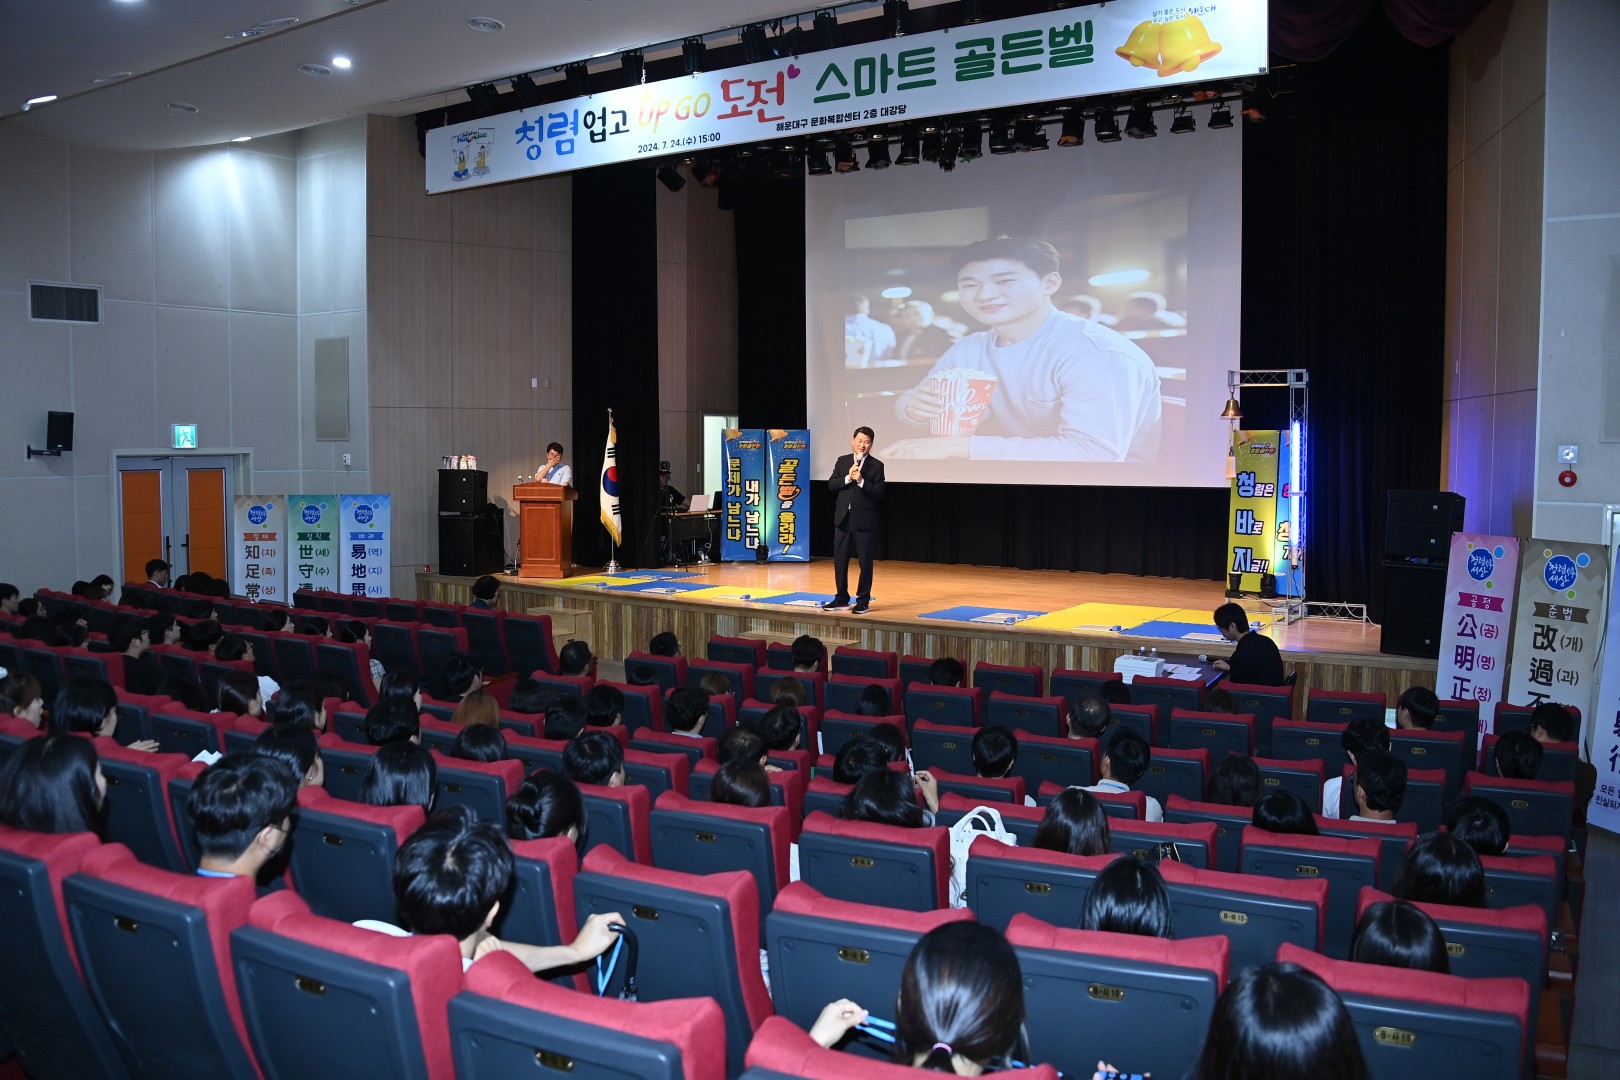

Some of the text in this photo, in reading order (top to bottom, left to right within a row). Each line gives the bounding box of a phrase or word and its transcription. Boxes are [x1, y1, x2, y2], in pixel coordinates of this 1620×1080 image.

[514, 19, 1095, 160] 청렴 업고 UP GO 도전 스마트 골든벨
[776, 104, 908, 132] 해운대구 문화복합센터 2층 대강당
[638, 142, 660, 154] 2024.
[662, 140, 669, 150] 7.
[698, 132, 721, 144] 15:00
[1236, 471, 1274, 498] 청렴은
[726, 458, 741, 542] 문제가 남느냐
[745, 480, 760, 550] 내가 남느냐
[1235, 509, 1264, 535] 바로
[244, 544, 276, 560] 知 (지)
[299, 544, 329, 559] 世 (세)
[351, 544, 382, 560] 易 (역)
[1233, 547, 1270, 573] 지금!!
[245, 564, 276, 578] 足 (족)
[299, 564, 329, 578] 守 (수)
[351, 564, 382, 578] 地 (지)
[1549, 574, 1570, 587] 세상
[262, 586, 276, 595] (상)
[368, 586, 382, 594] (사)
[1471, 595, 1491, 609] 공정
[1548, 604, 1573, 620] 준법
[1456, 614, 1499, 639] 公 (공)
[1532, 624, 1583, 652] 改 (개)
[1454, 644, 1495, 672] 明 (명)
[1528, 657, 1579, 686] 過 (과)
[1451, 676, 1492, 702] 正 (정)
[1600, 784, 1615, 796] 모든
